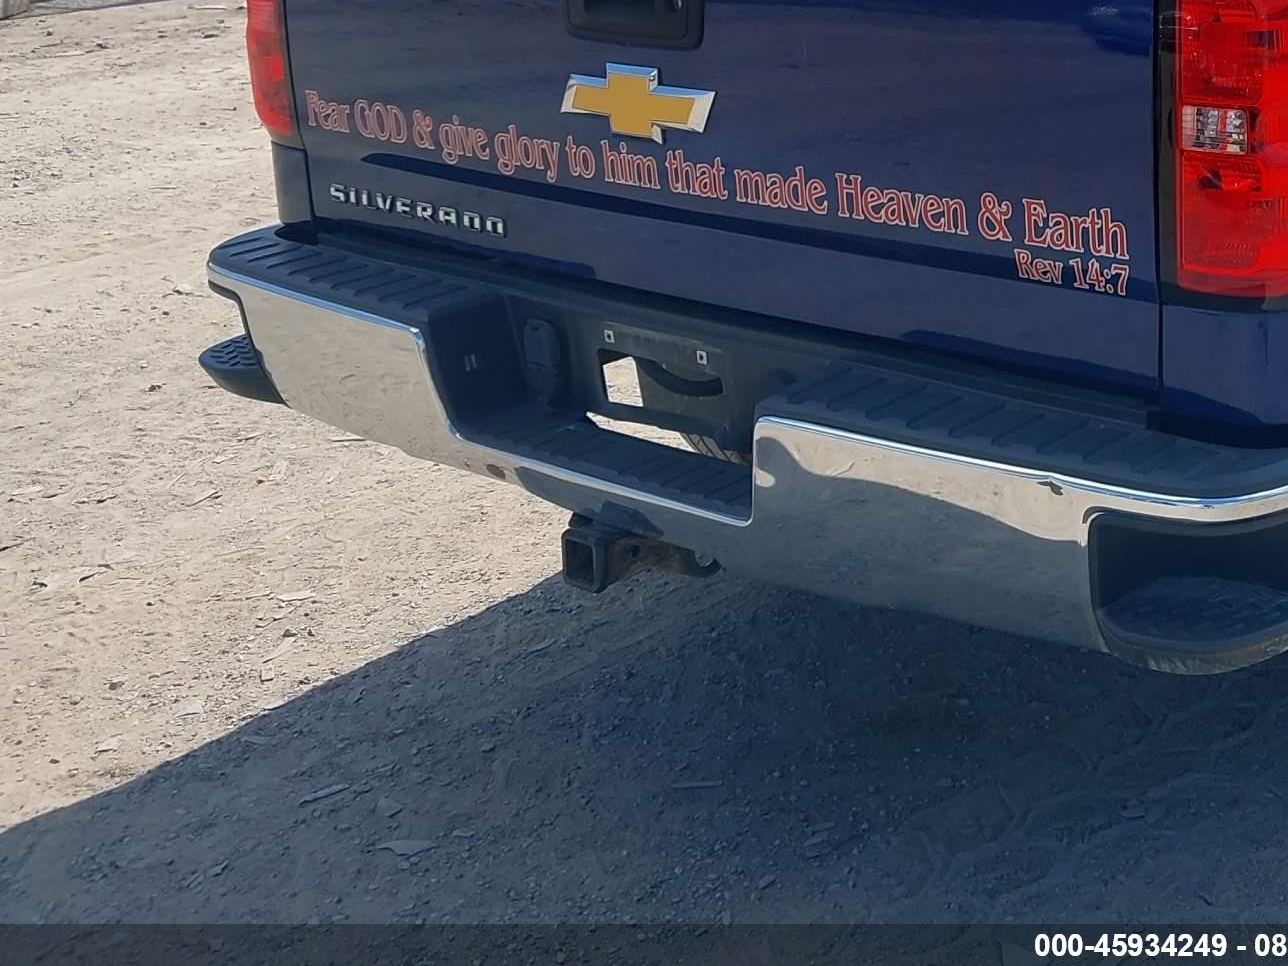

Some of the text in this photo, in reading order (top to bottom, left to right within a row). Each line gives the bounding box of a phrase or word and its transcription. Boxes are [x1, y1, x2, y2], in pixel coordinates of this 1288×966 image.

[305, 89, 1130, 261] Fear GOD & give glory to him that made Heaven & Earth
[329, 183, 507, 238] SILVERADO
[1013, 248, 1130, 296] Rev 14:7
